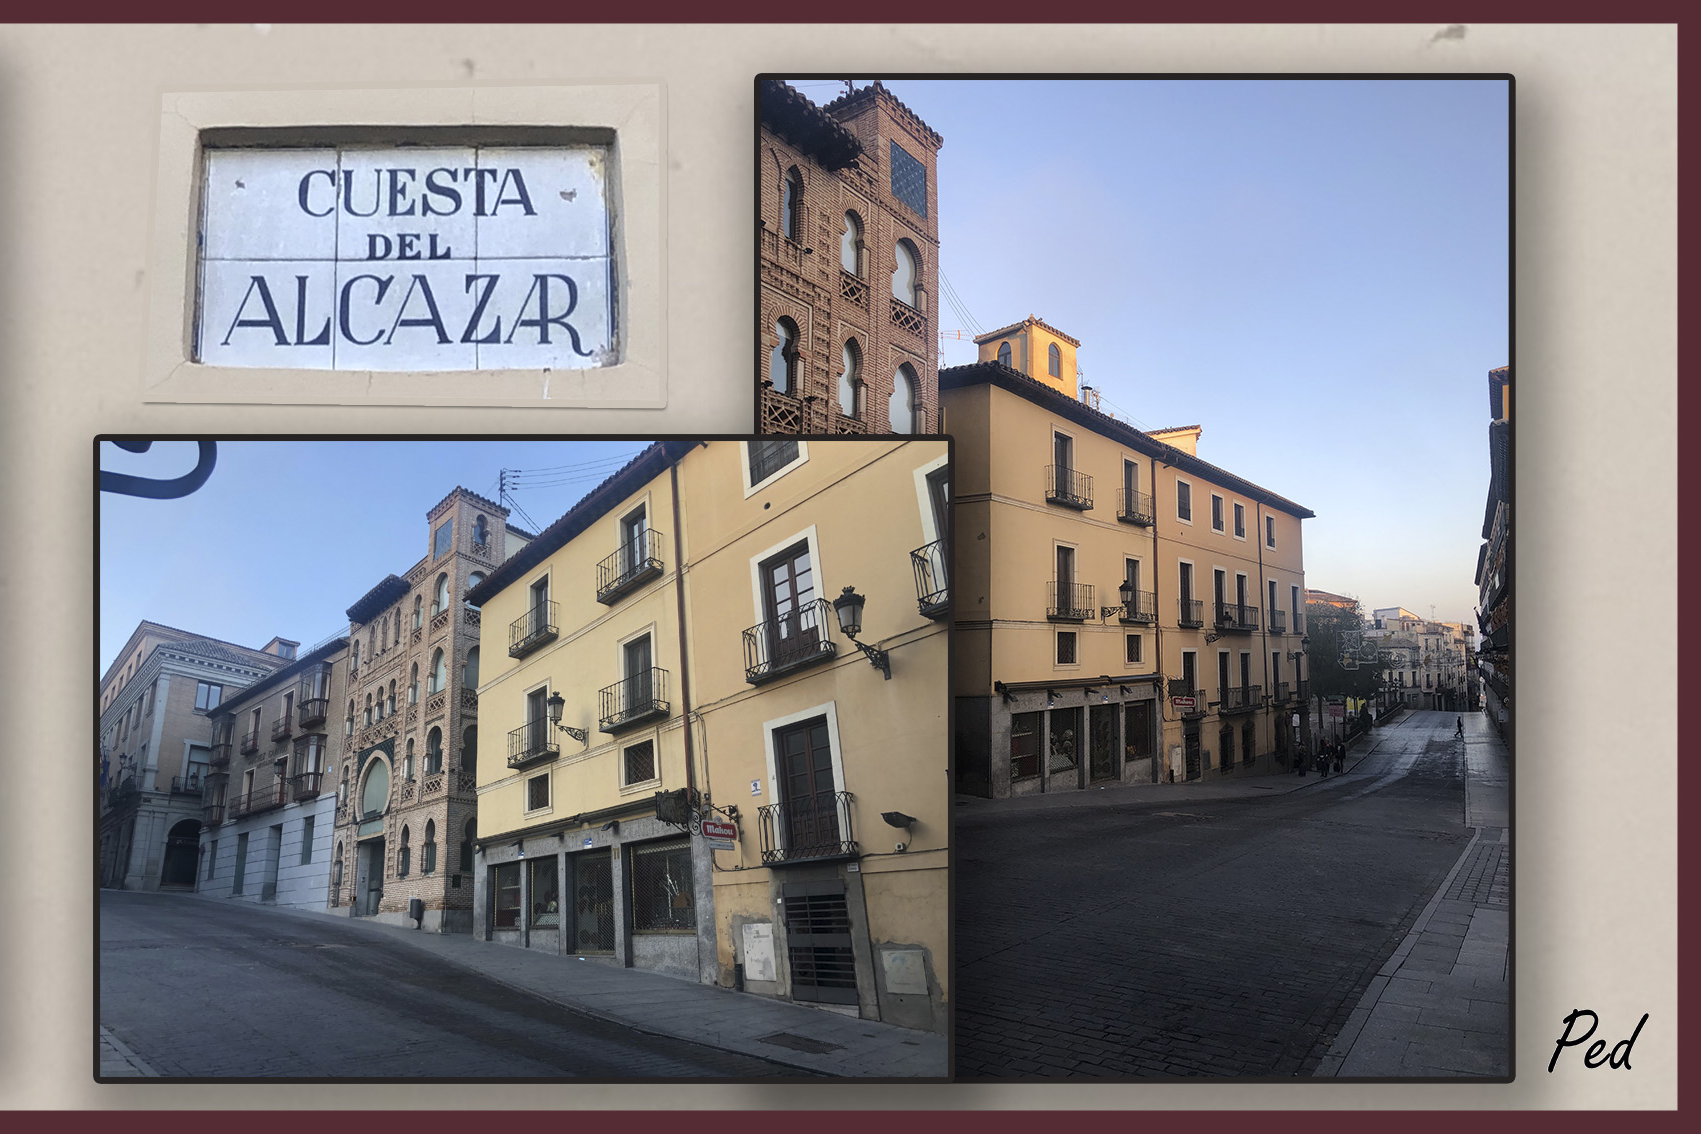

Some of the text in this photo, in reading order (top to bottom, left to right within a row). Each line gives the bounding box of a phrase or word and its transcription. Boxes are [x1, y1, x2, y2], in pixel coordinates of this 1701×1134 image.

[298, 167, 538, 218] CUESTA
[366, 233, 452, 261] DEL
[220, 274, 594, 357] ALCAZAR
[706, 824, 734, 836] Mahou
